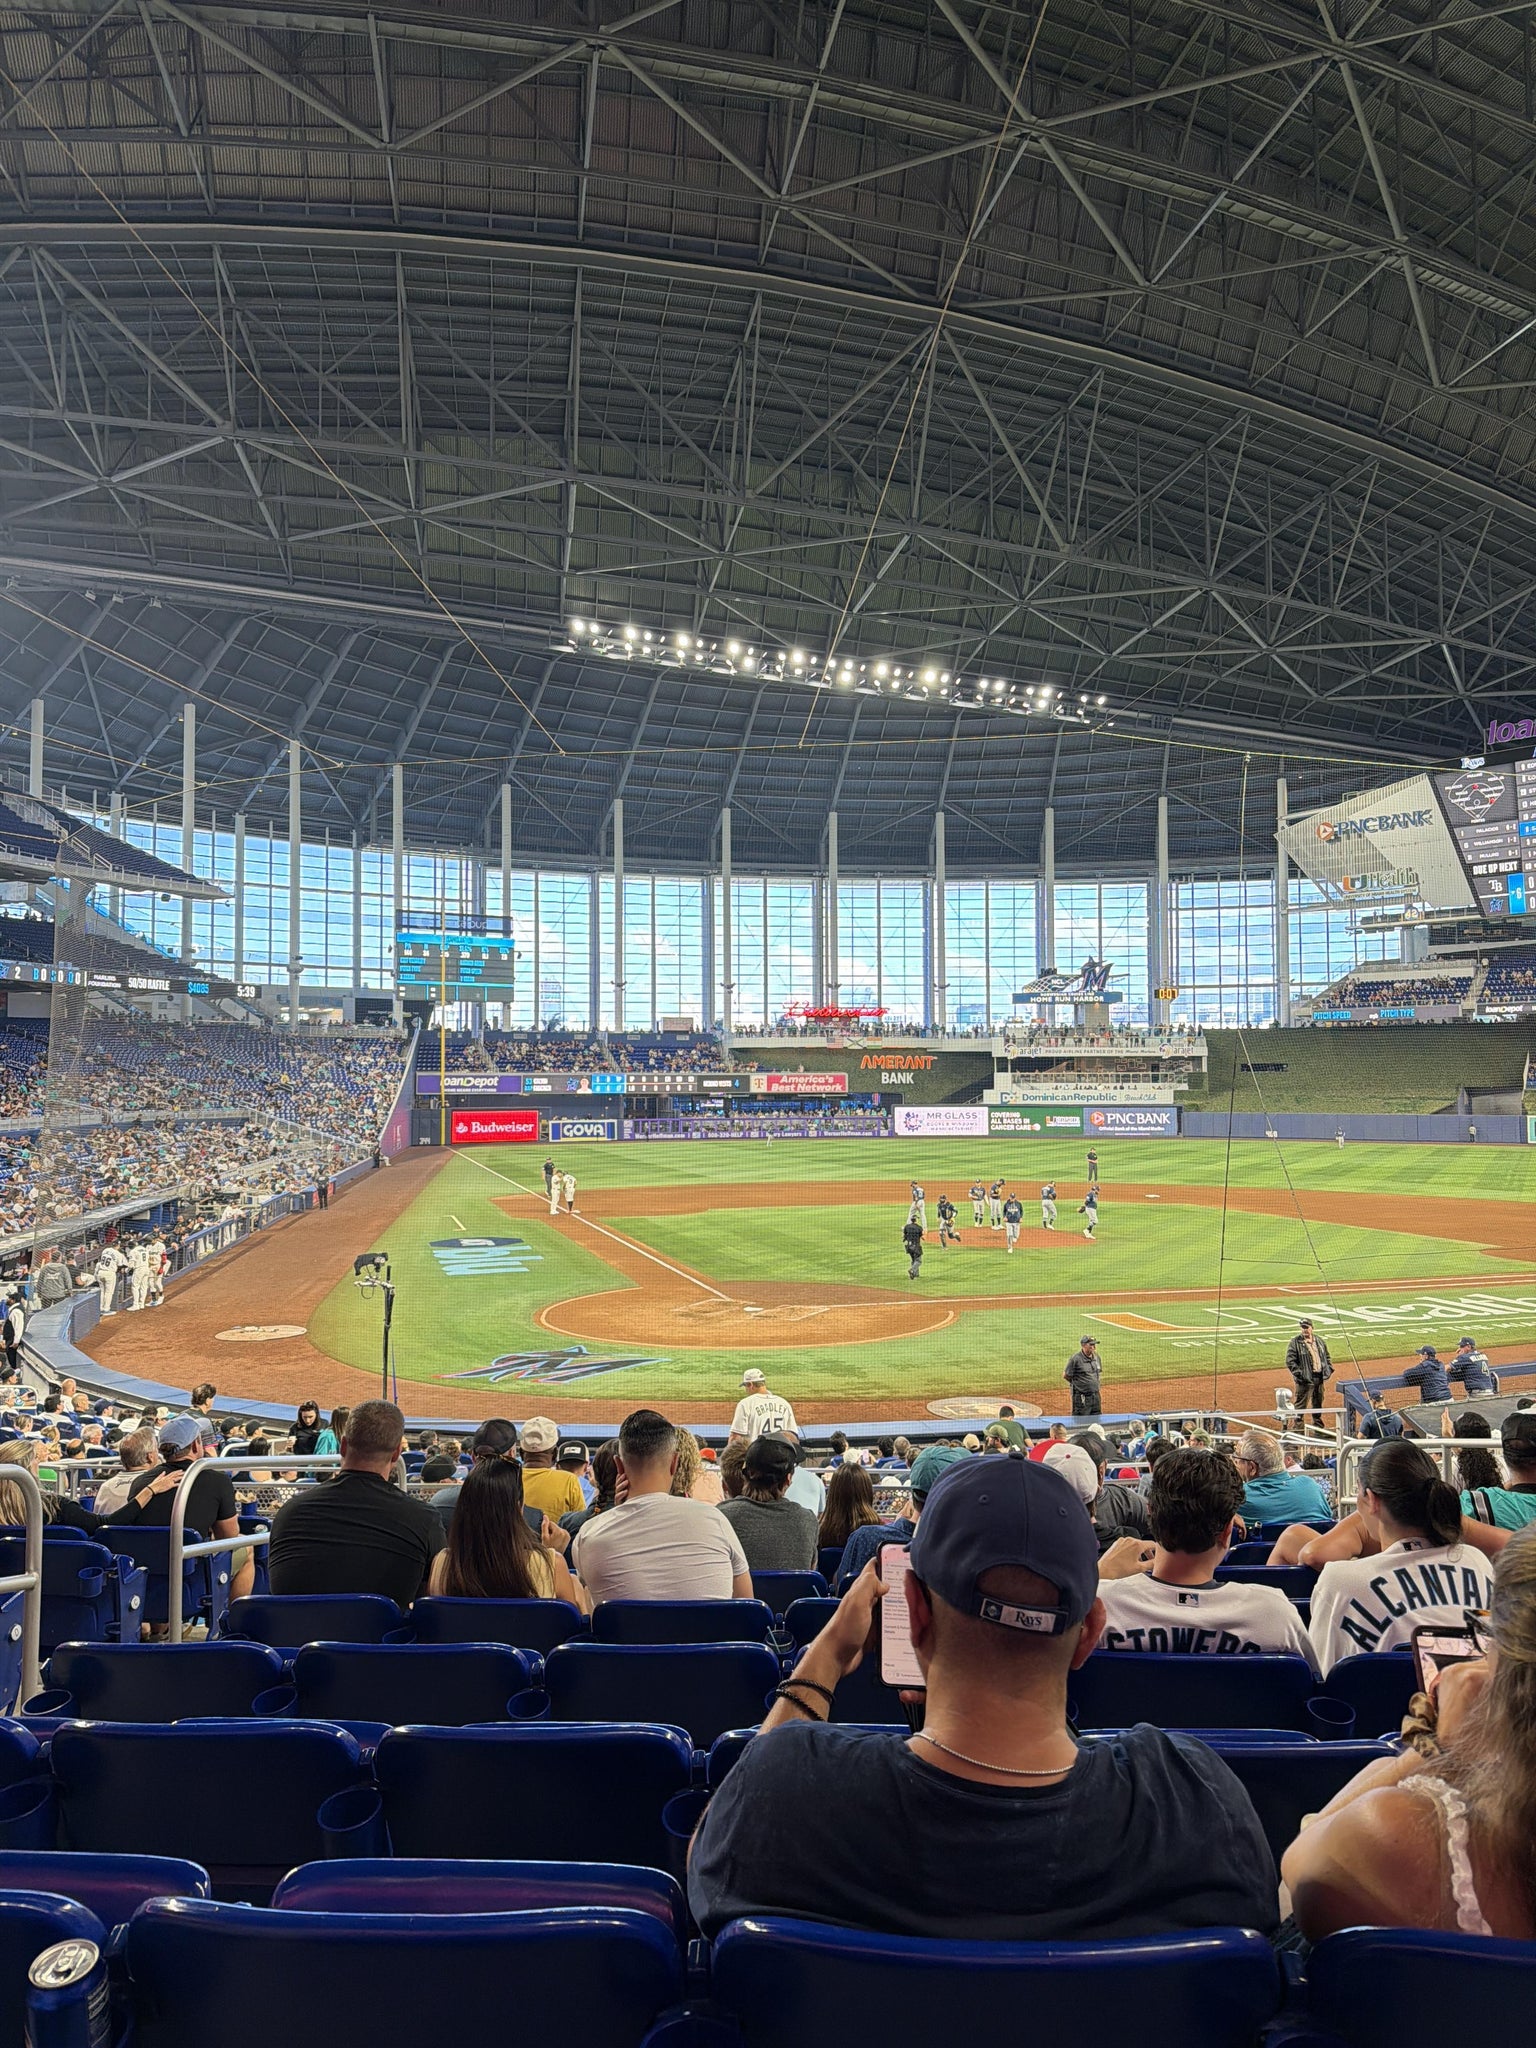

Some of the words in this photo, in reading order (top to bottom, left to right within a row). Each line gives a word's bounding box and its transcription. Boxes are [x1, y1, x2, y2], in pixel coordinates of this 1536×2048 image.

[1487, 719, 1536, 745] loa
[1472, 864, 1487, 875] DUE
[1488, 863, 1498, 873] UP
[1499, 861, 1518, 872] NEXT
[237, 985, 255, 998] 5:39
[1313, 1011, 1332, 1019] PITCH
[1332, 1011, 1351, 1019] SPEED
[1380, 1009, 1399, 1018] PITCH
[1400, 1008, 1415, 1017] TYPE
[1020, 1043, 1041, 1058] arajet
[1173, 1043, 1194, 1058] arajet
[860, 1055, 934, 1070] AMERANT
[779, 1075, 834, 1084] America's
[881, 1072, 914, 1085] BANK
[771, 1083, 796, 1092] Best
[796, 1083, 842, 1092] Network
[926, 1112, 942, 1120] MR
[944, 1112, 978, 1120] GLASS
[471, 1121, 534, 1133] Budweiser
[562, 1123, 605, 1138] GOYA
[755, 1402, 788, 1417] BRADLEY
[762, 1417, 784, 1434] 45
